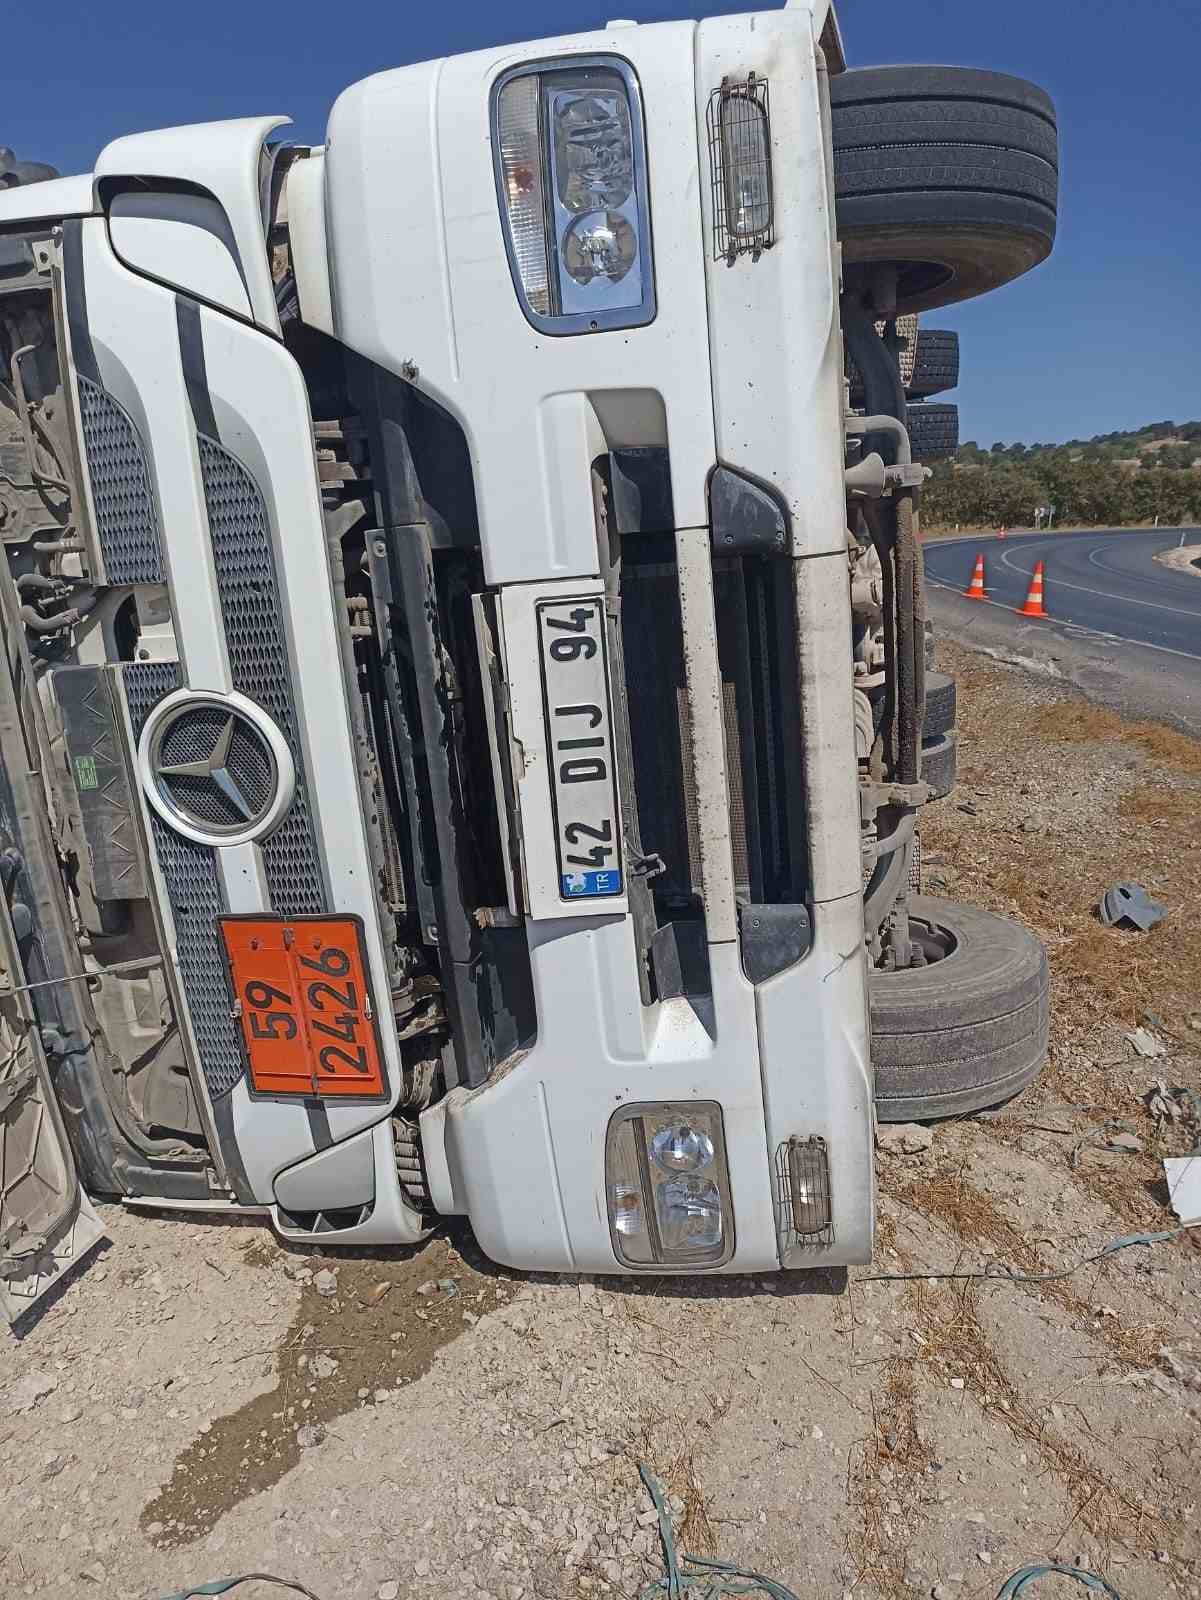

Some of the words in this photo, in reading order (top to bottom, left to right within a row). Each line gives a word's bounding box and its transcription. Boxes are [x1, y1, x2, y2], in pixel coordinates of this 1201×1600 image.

[546, 608, 597, 662] 94
[555, 704, 607, 784] DIJ
[565, 819, 612, 867] 42
[595, 873, 608, 892] TR
[245, 980, 297, 1040] 59
[300, 948, 369, 1073] 2426
